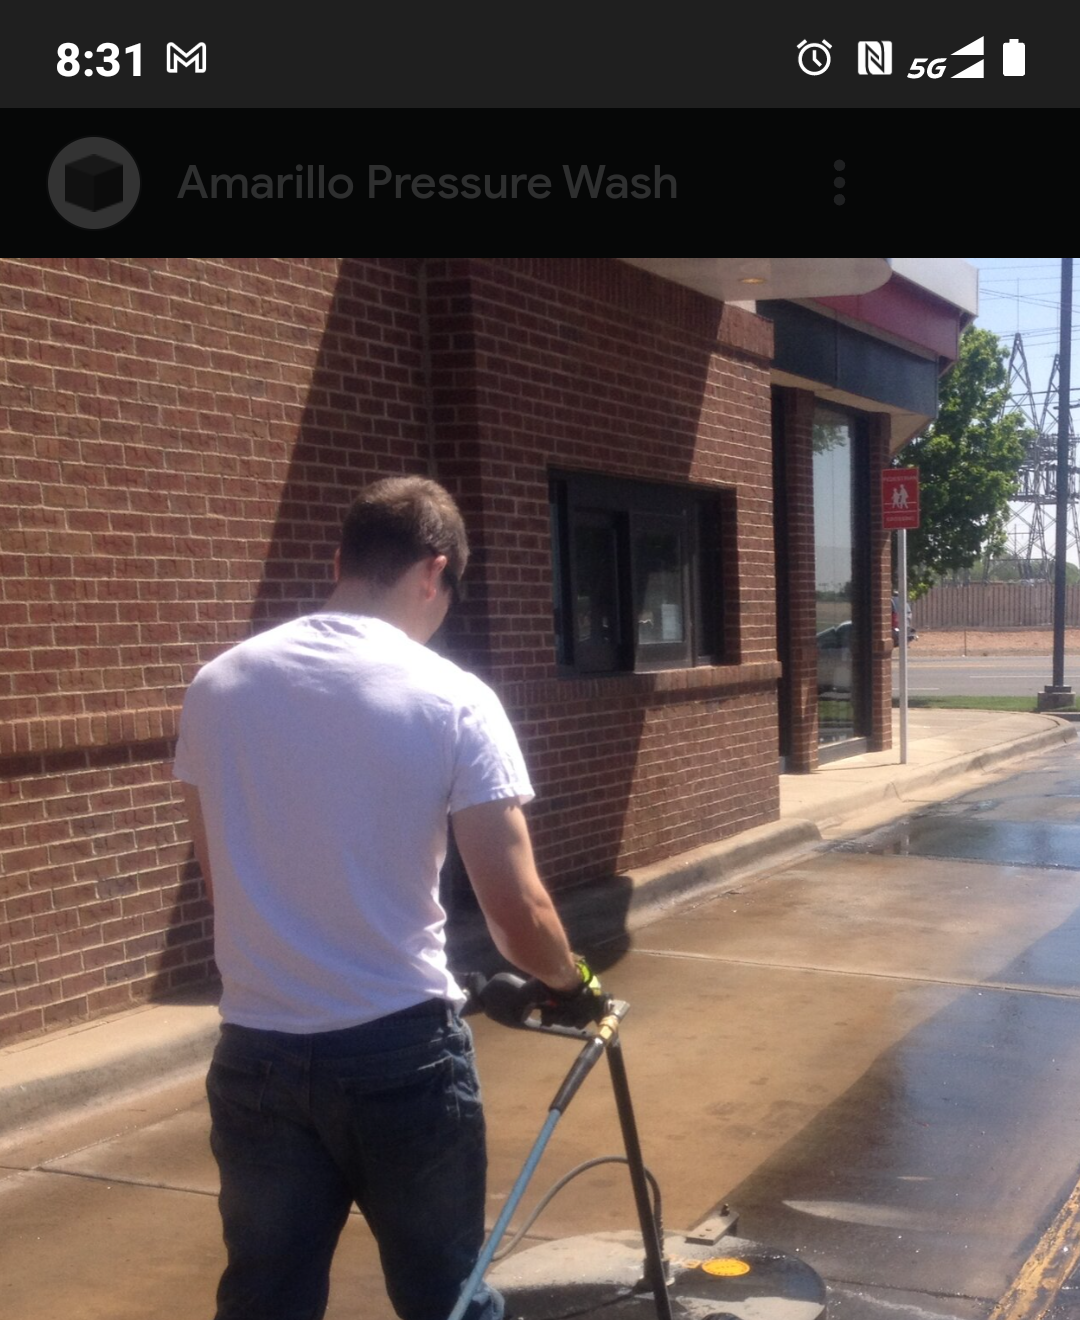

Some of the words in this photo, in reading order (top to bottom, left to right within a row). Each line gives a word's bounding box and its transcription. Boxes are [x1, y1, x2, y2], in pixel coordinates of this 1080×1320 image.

[57, 43, 142, 78] 8:31
[906, 57, 948, 80] 5G
[176, 163, 354, 200] Amarillo
[368, 164, 552, 200] Pressure
[561, 164, 678, 200] Wash
